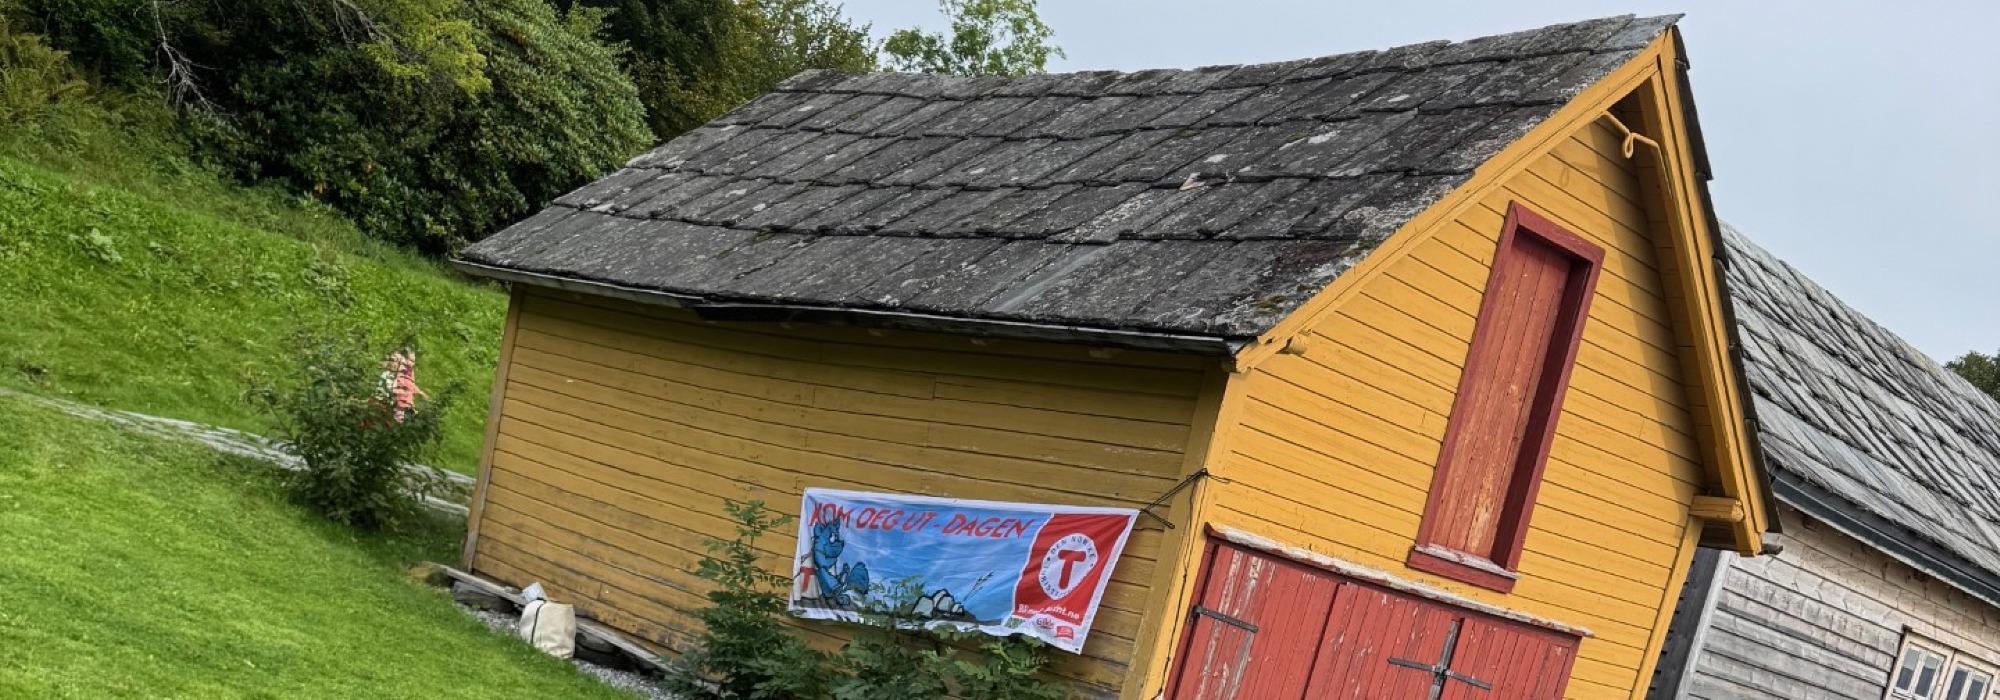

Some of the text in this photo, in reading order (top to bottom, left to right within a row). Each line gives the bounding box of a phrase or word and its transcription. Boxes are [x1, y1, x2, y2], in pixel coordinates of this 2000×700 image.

[808, 501, 854, 528] KOM
[856, 507, 904, 532] OEG
[902, 511, 940, 534] UT
[941, 513, 1034, 539] DAGEN
[1058, 550, 1087, 590] T
